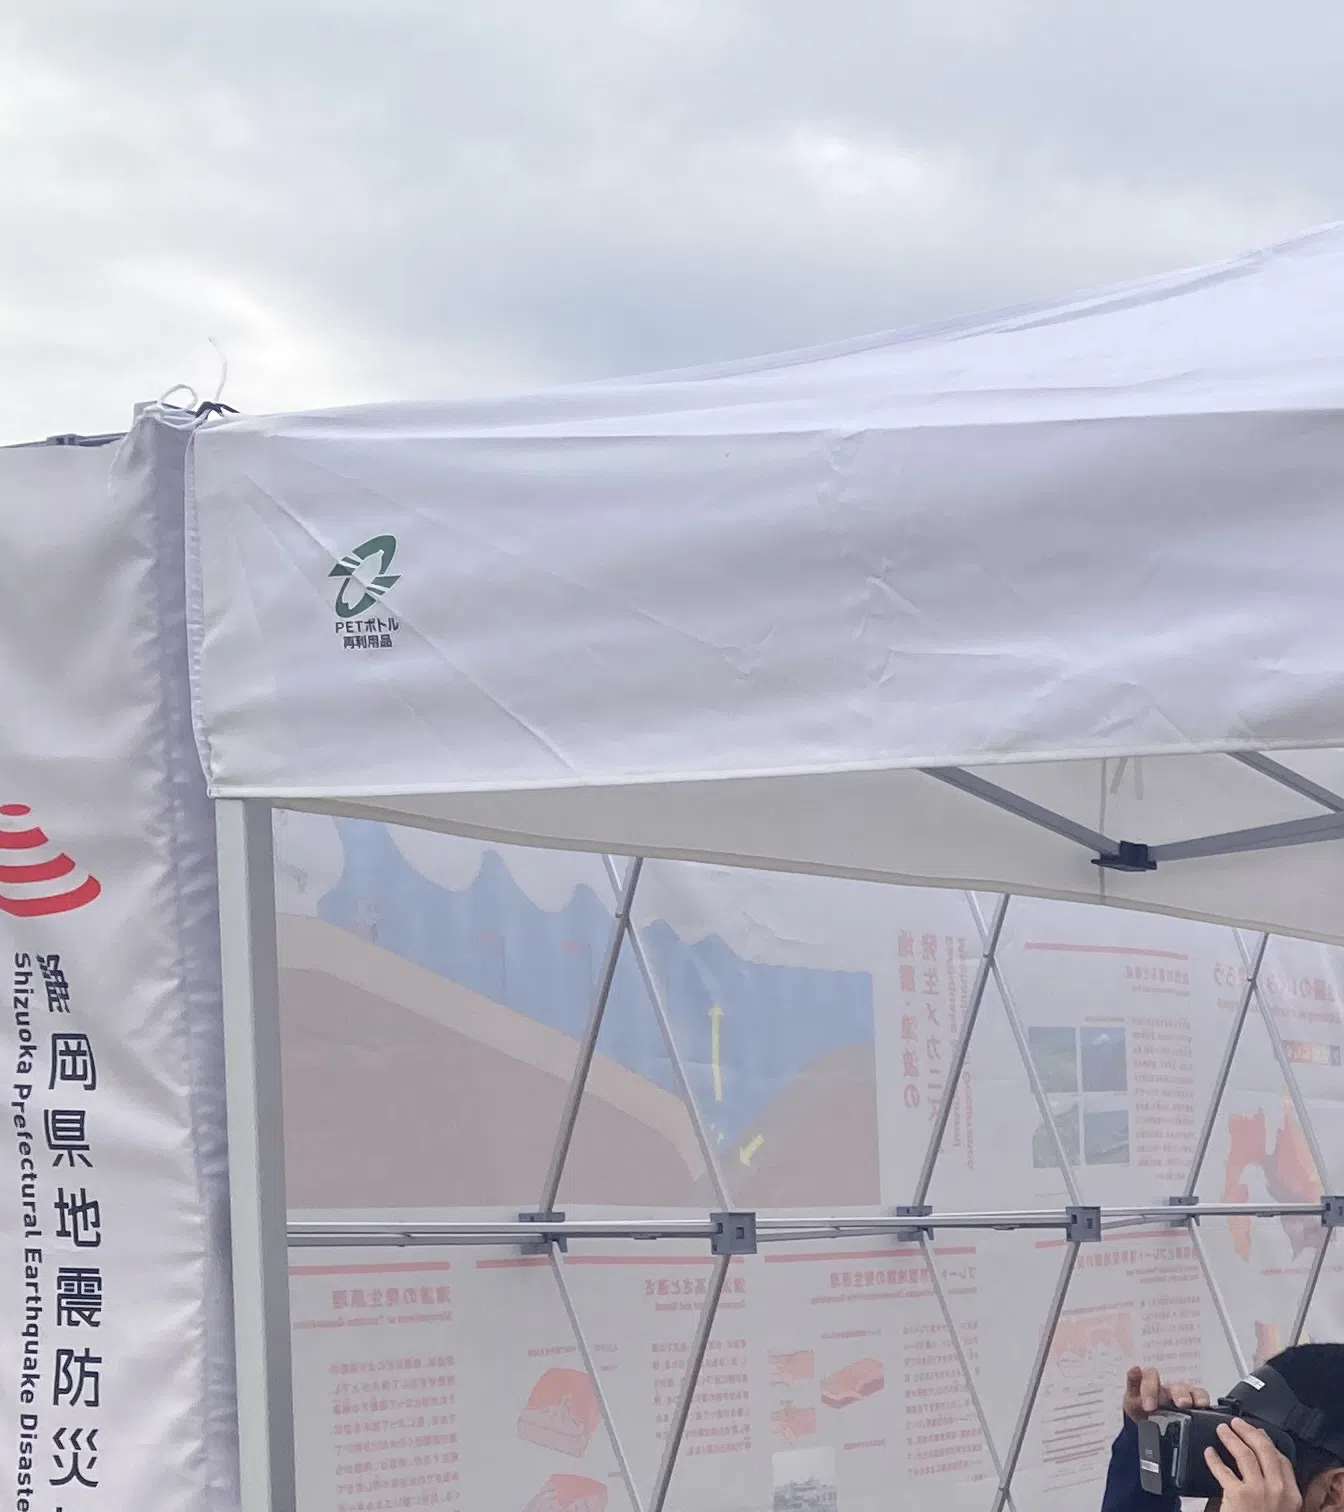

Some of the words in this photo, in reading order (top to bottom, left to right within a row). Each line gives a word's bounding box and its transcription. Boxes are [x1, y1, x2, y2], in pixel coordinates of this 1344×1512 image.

[335, 618, 400, 633] PETボトル
[343, 634, 393, 649] 再利用品
[13, 951, 38, 1075] Shizuoka
[11, 1083, 43, 1240] Prefectural
[20, 1247, 44, 1404] Earthquake
